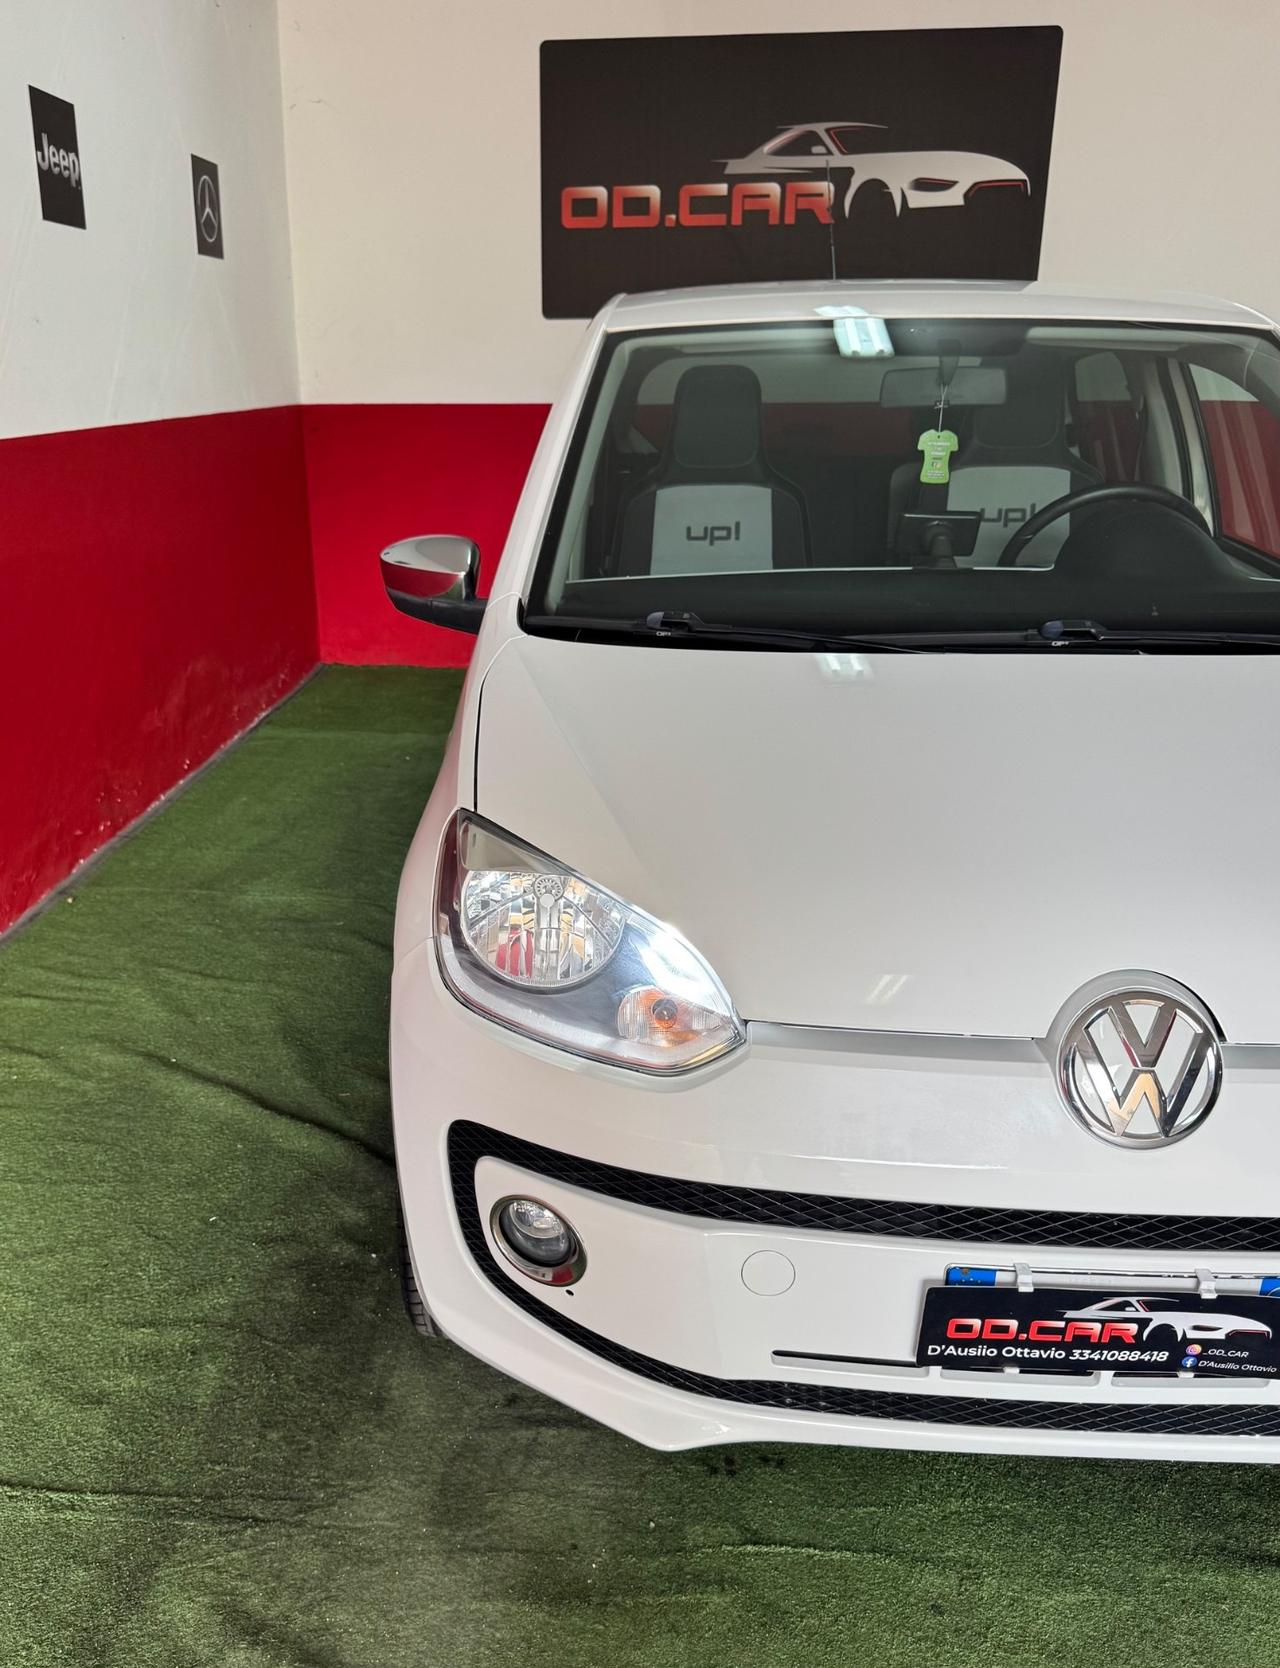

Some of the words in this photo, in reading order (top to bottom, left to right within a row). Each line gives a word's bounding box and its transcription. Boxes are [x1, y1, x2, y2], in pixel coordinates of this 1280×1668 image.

[37, 132, 80, 188] Jeep
[561, 181, 835, 229] OD.CAR
[686, 520, 741, 546] up!
[946, 1318, 1139, 1343] OD.CAR
[1001, 1346, 1066, 1359] Ottavio
[1069, 1349, 1169, 1361] 3341088418
[1241, 1364, 1277, 1373] Ottavio
